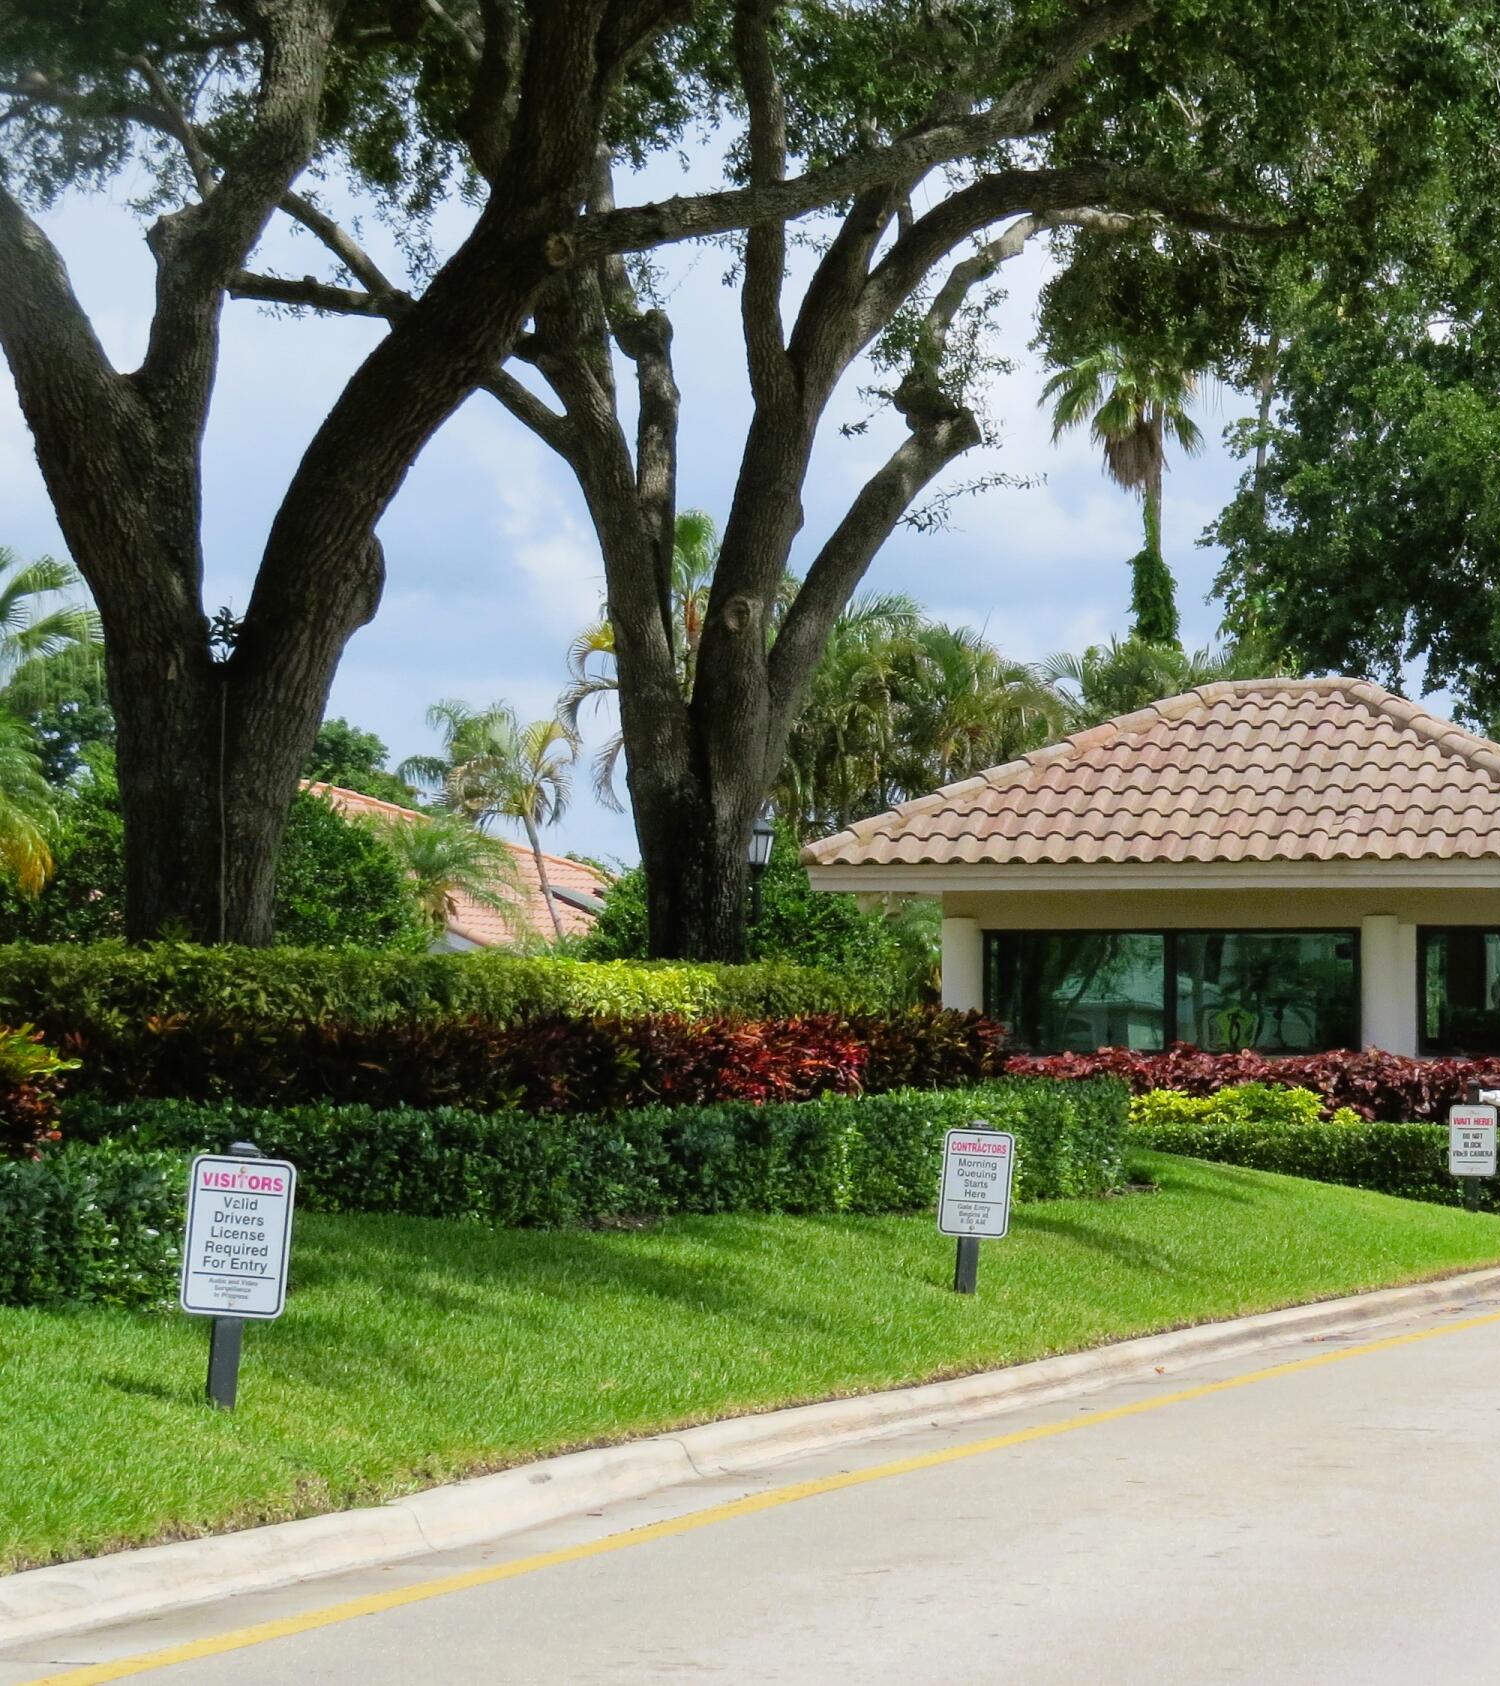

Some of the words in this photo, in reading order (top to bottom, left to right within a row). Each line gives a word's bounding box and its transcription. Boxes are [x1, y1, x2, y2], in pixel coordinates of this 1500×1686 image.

[1453, 1117, 1471, 1125] WAIT
[951, 1141, 1007, 1154] CONTRACTORS
[958, 1158, 997, 1171] Morning
[957, 1168, 997, 1181] Queuing
[203, 1172, 284, 1192] VISITORS
[964, 1178, 988, 1189] Starts
[964, 1189, 986, 1199] Here
[224, 1196, 258, 1211] Valid
[214, 1211, 264, 1226] Drivers
[211, 1227, 265, 1241] License
[205, 1241, 269, 1257] Required
[203, 1256, 226, 1269] For
[231, 1258, 268, 1275] Entry
